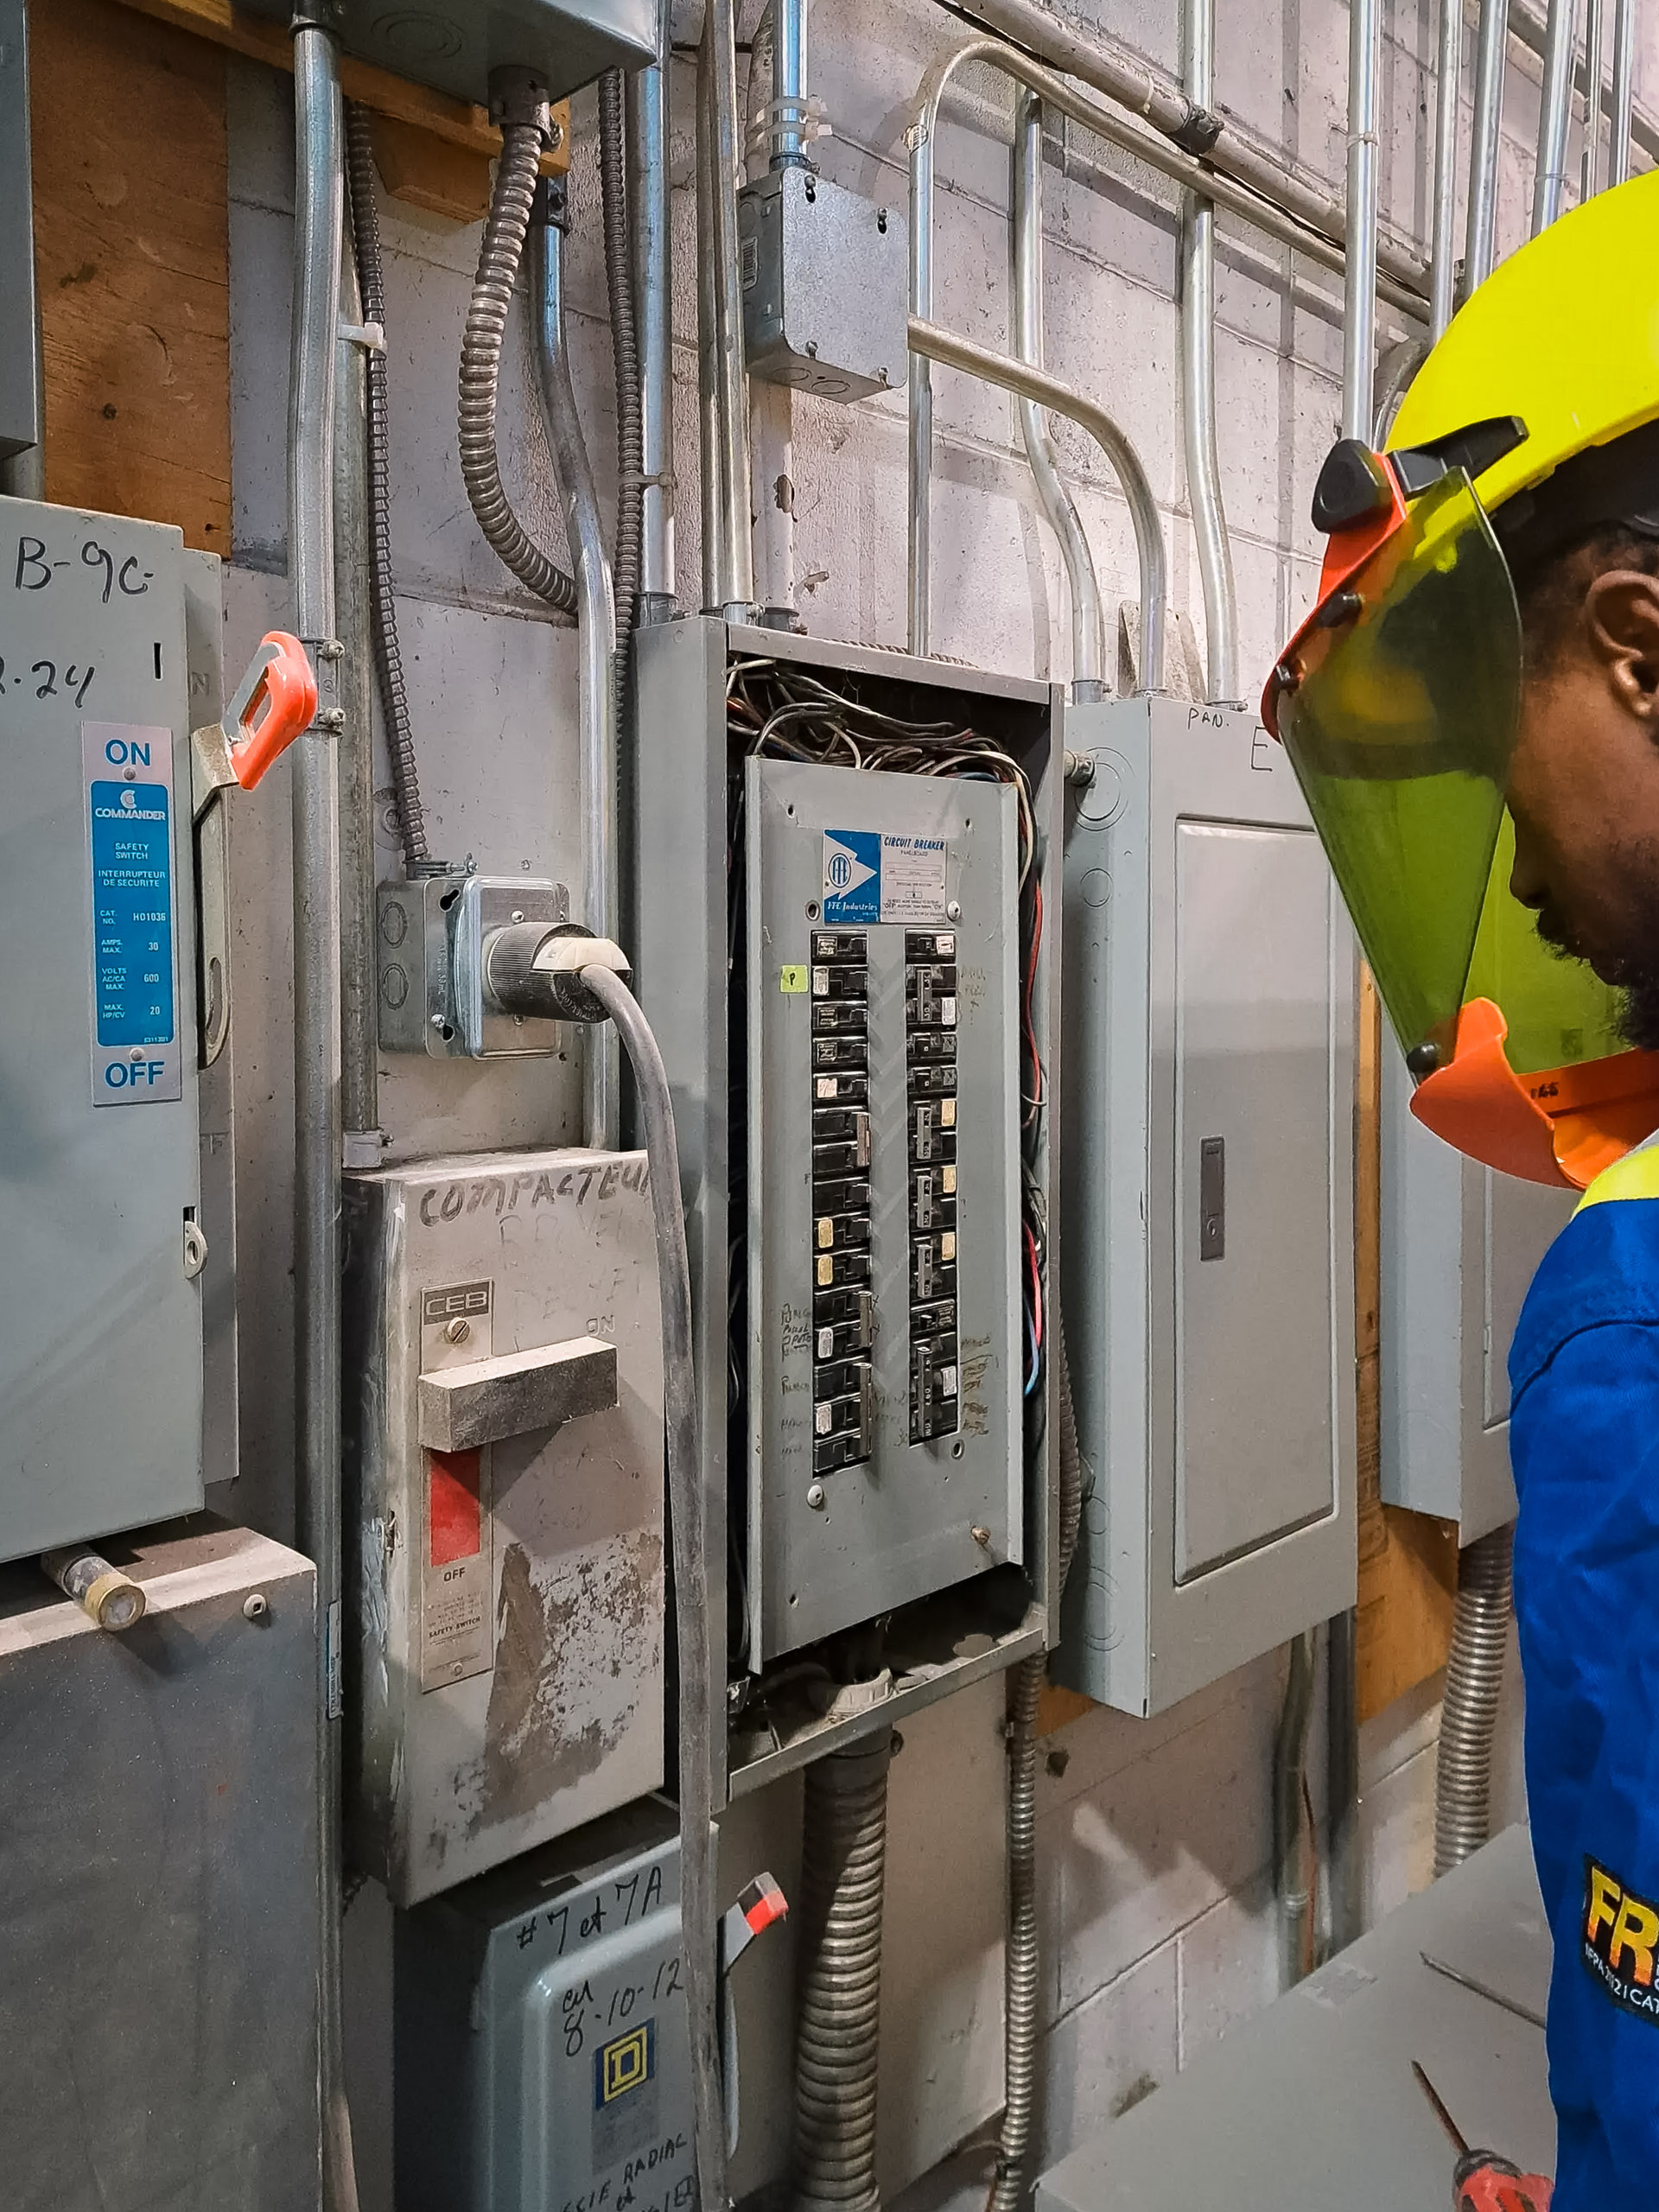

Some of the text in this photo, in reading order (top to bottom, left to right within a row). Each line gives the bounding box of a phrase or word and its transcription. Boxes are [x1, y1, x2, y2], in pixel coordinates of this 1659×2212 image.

[105, 739, 151, 766] ON
[1251, 726, 1273, 772] E
[95, 808, 165, 820] COMMANDER
[115, 842, 149, 851] SAFETY
[884, 836, 944, 851] CIRCUIT BREAKER
[115, 851, 148, 860] SWITCH
[99, 869, 165, 879] INTERRUPTEUR
[149, 942, 159, 950] 30
[143, 974, 159, 982] 600
[150, 1007, 160, 1015] 20
[105, 1061, 165, 1088] OFF
[426, 1290, 486, 1316] CEB
[443, 1567, 466, 1582] OFF
[429, 1626, 453, 1639] SAFETY
[456, 1616, 480, 1630] SWITCH
